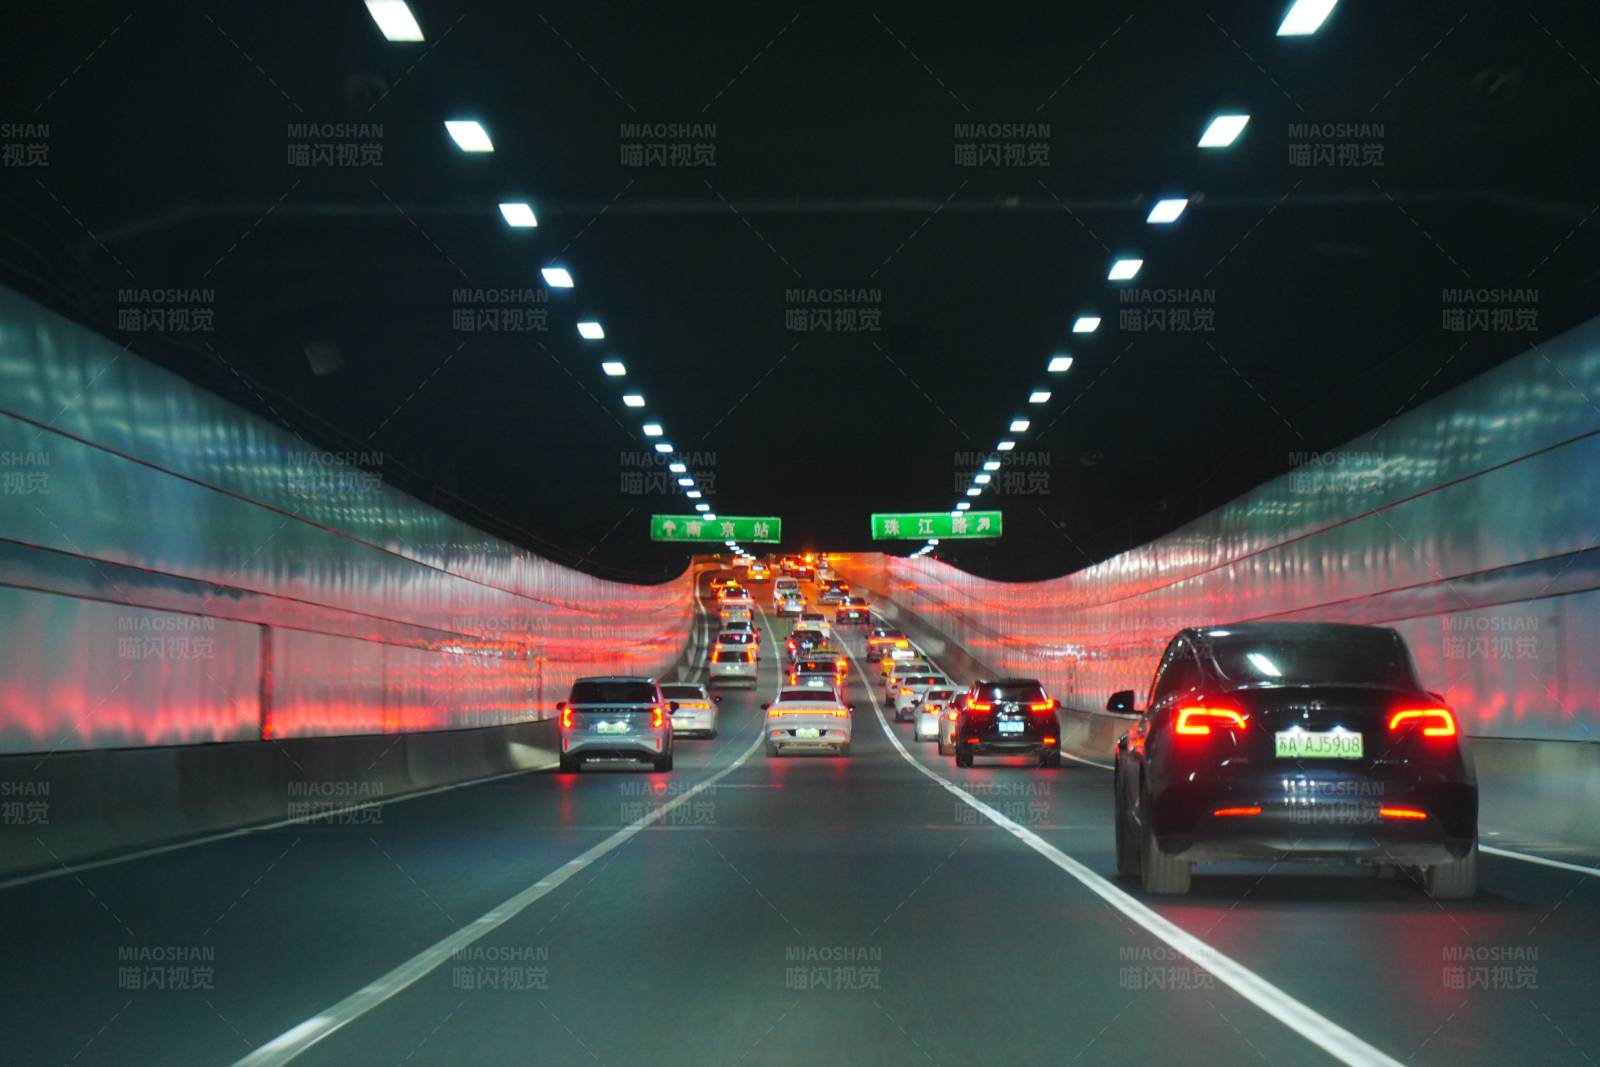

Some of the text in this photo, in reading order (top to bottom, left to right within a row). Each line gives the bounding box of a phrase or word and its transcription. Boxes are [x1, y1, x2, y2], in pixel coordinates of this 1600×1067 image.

[685, 520, 770, 539] 南京站
[884, 517, 968, 536] 珠江路
